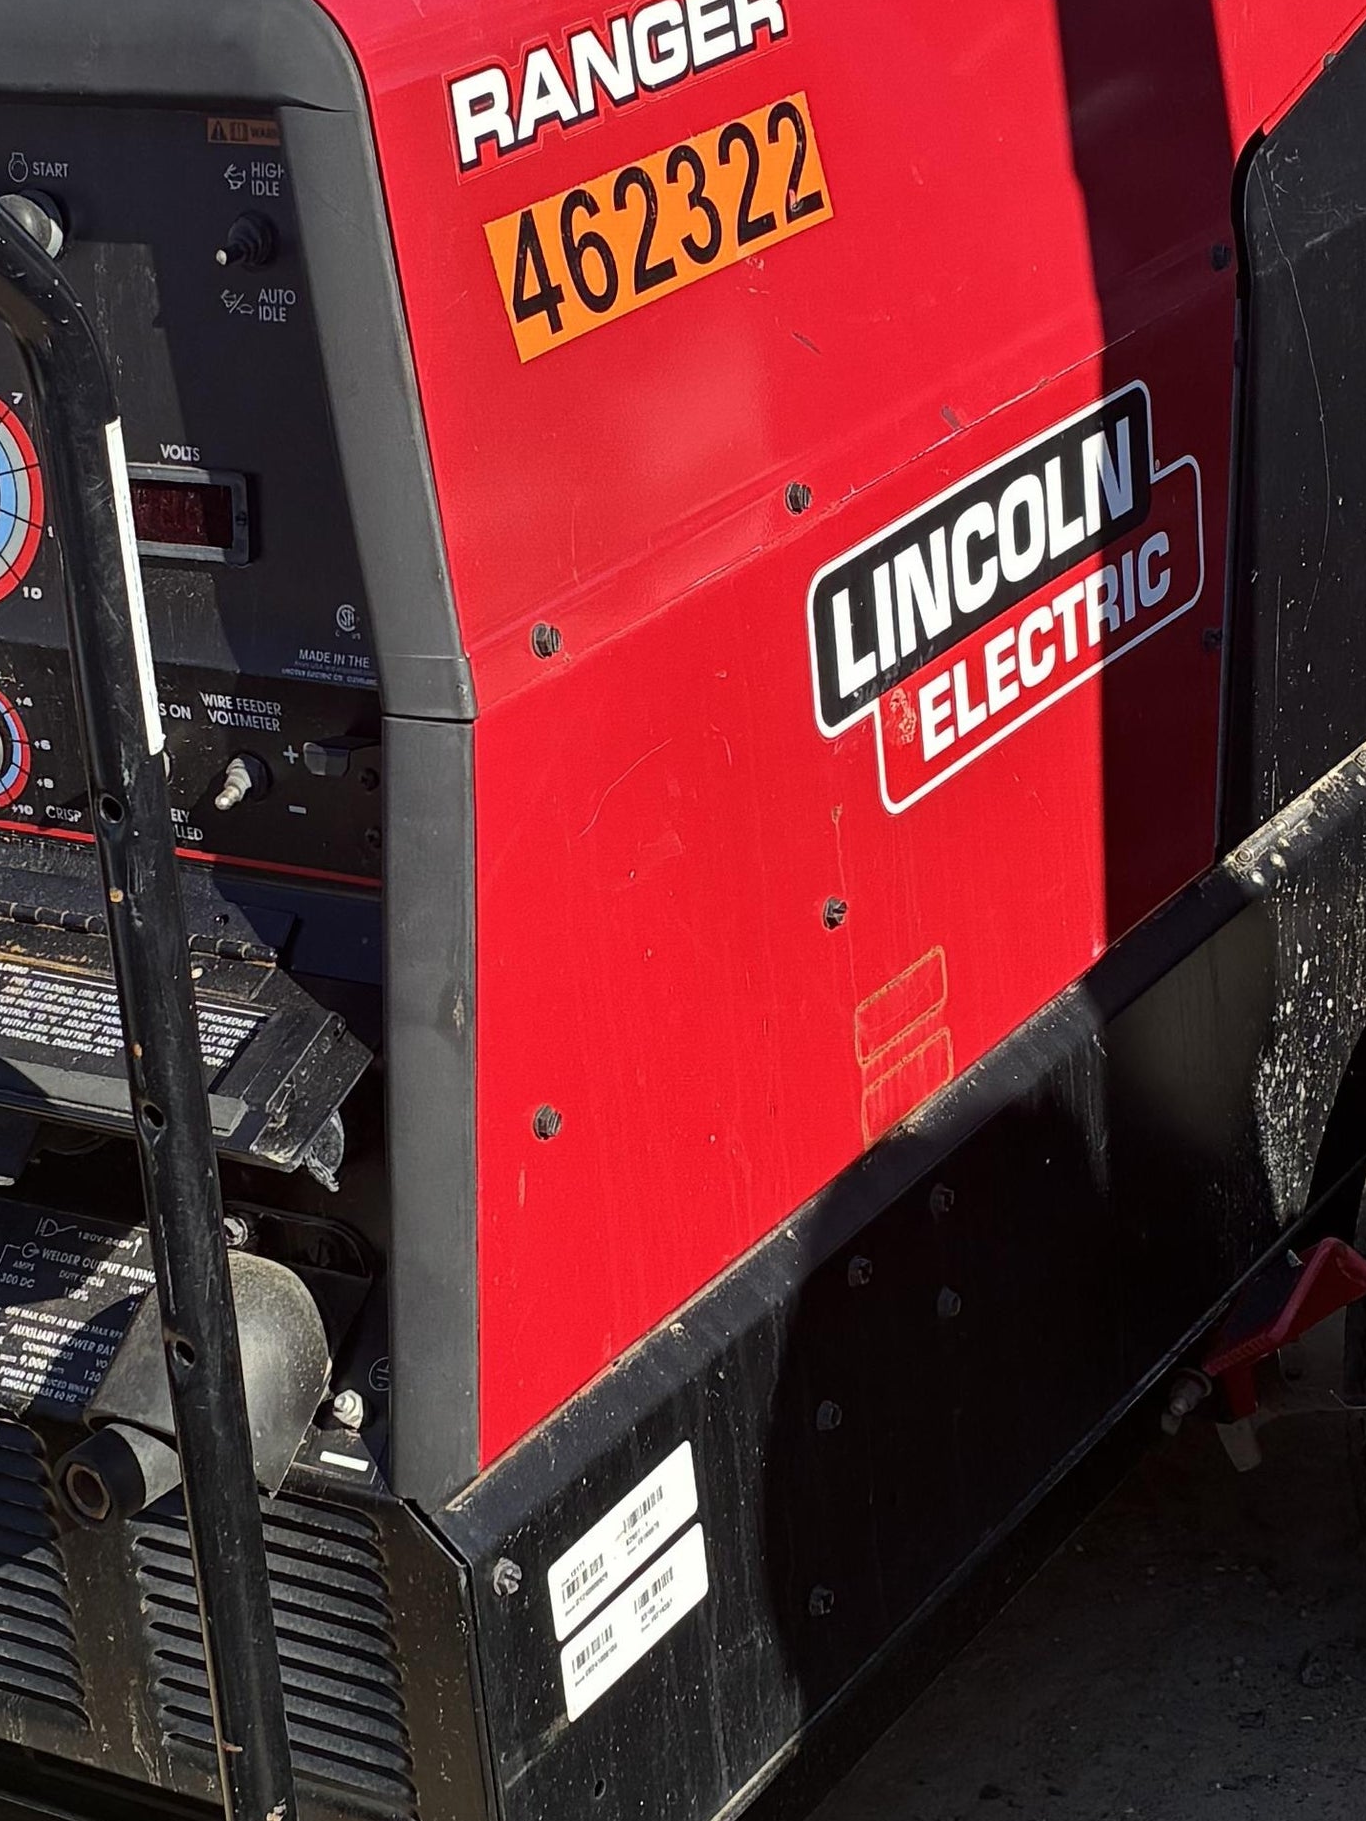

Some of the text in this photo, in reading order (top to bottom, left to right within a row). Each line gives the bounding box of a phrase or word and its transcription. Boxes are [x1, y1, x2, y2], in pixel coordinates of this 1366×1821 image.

[32, 161, 69, 179] START
[251, 180, 280, 196] IDLE
[511, 101, 825, 335] 462322
[258, 288, 296, 306] AUTO
[258, 306, 287, 323] IDLE
[11, 392, 23, 405] 7
[160, 443, 201, 463] VOLTS
[832, 416, 1134, 700] LINCOLN
[23, 586, 43, 600] 10
[918, 530, 1172, 763] ELECTRIC
[298, 648, 371, 670] MADE IN THE
[169, 703, 192, 721] ON
[199, 690, 283, 718] WIRE FEEDER
[207, 708, 282, 733] VOLTMETER
[45, 804, 83, 823] CRISP
[41, 1247, 157, 1284] WELDER OUTPUT RATING
[19, 1277, 36, 1289] DC
[9, 1322, 98, 1353] AUXILIARY POWER
[18, 1354, 48, 1371] 9,000
